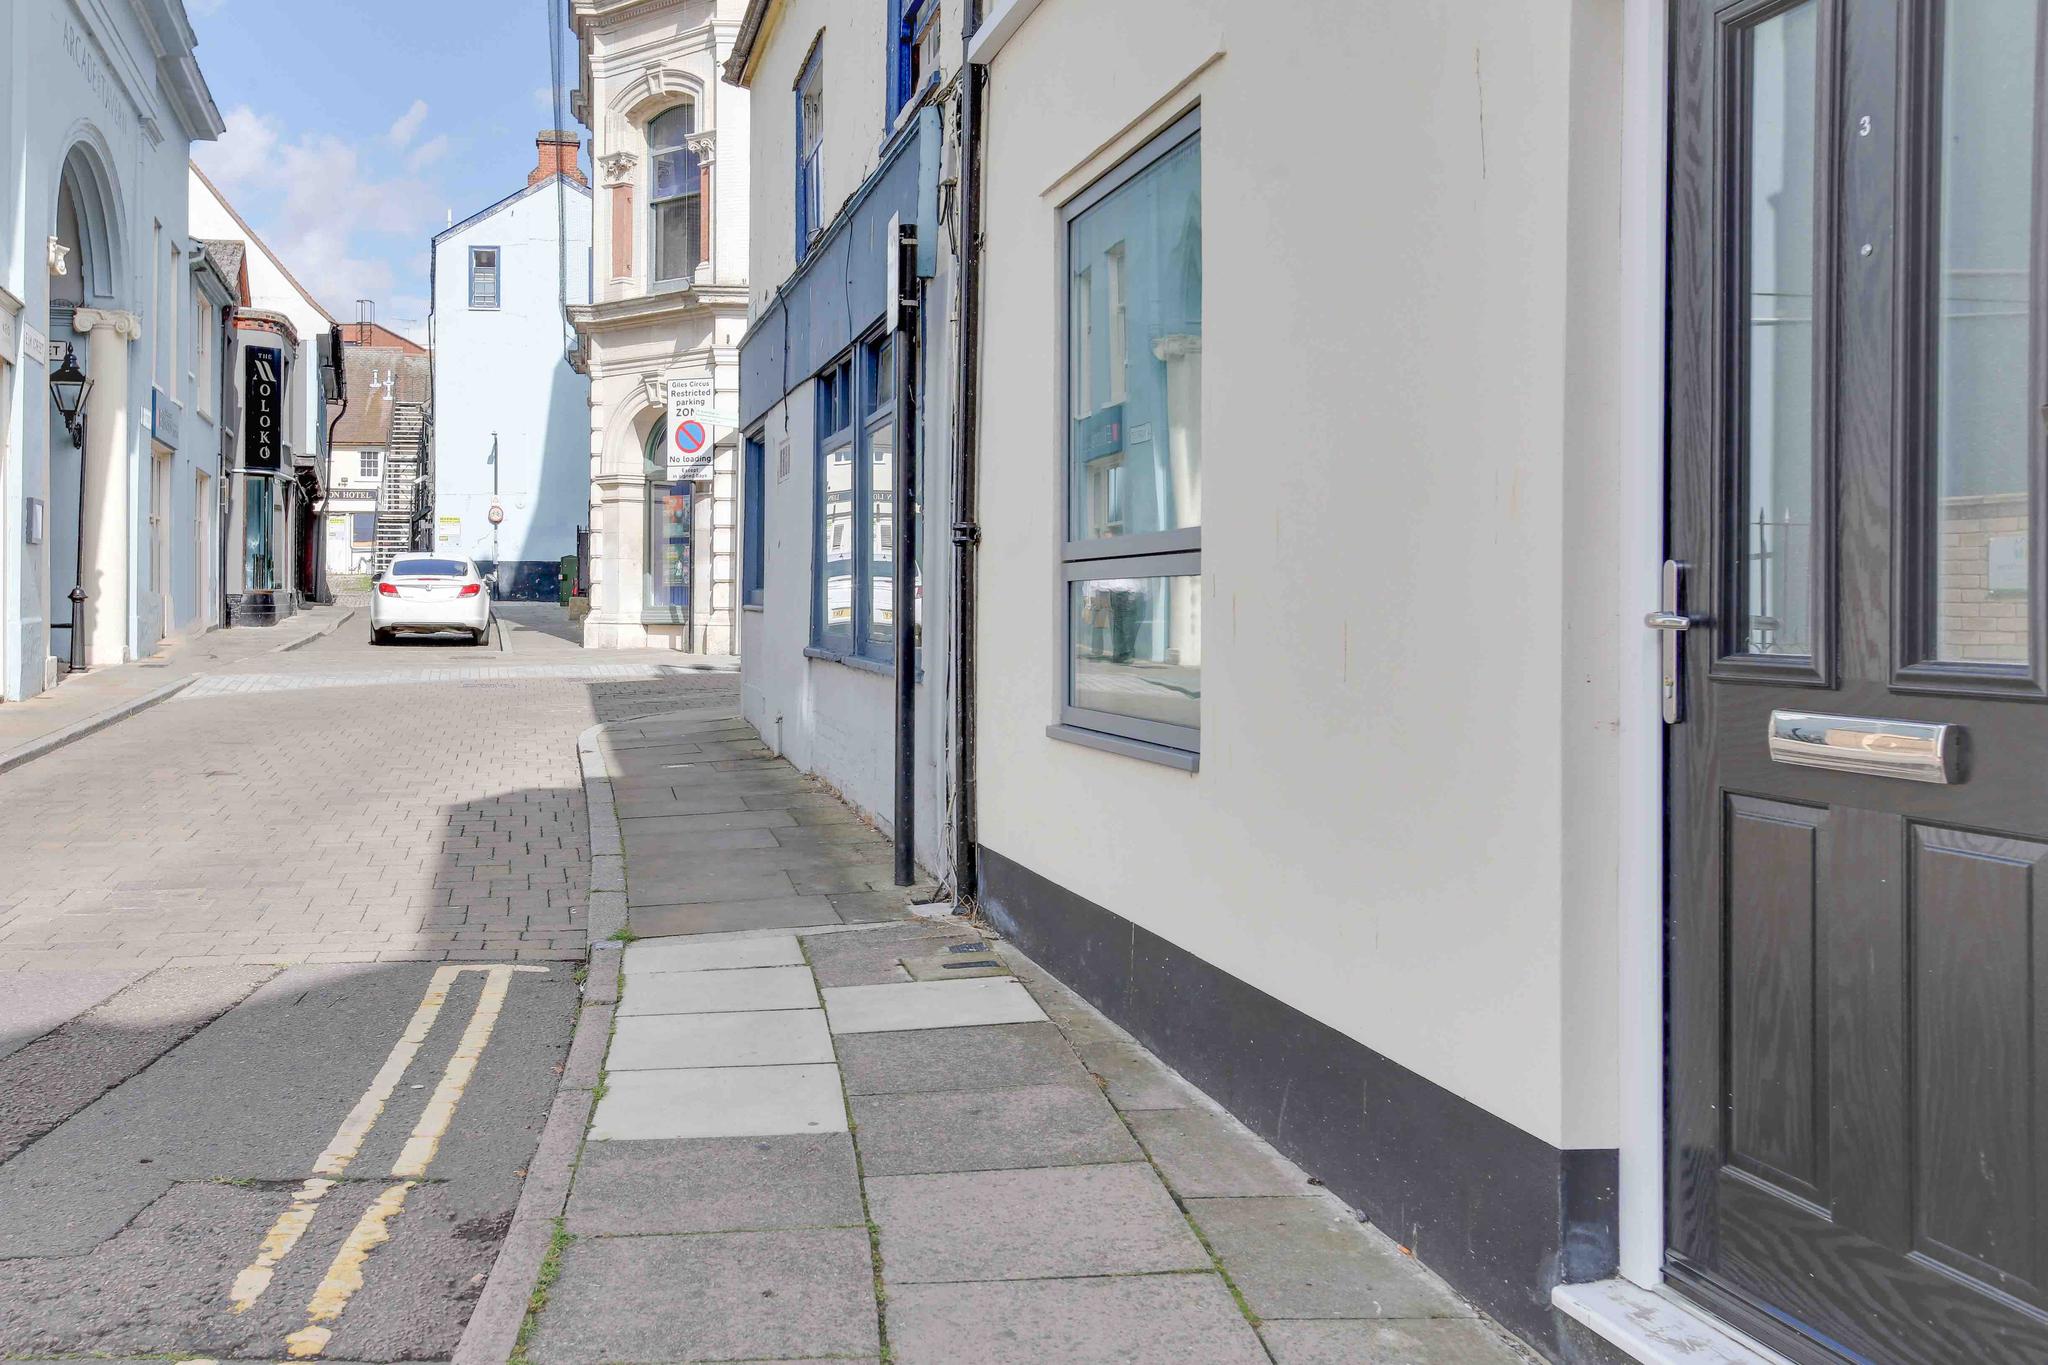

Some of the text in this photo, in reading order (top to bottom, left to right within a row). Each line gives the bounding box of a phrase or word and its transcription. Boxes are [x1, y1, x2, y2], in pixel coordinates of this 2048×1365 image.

[63, 19, 97, 92] ARCADE
[1859, 115, 1872, 137] 3
[257, 352, 273, 360] THE
[671, 389, 711, 397] Restricted
[676, 398, 706, 407] parking
[676, 408, 695, 417] ZON
[669, 454, 712, 463] No loading
[342, 491, 371, 499] HOTEL
